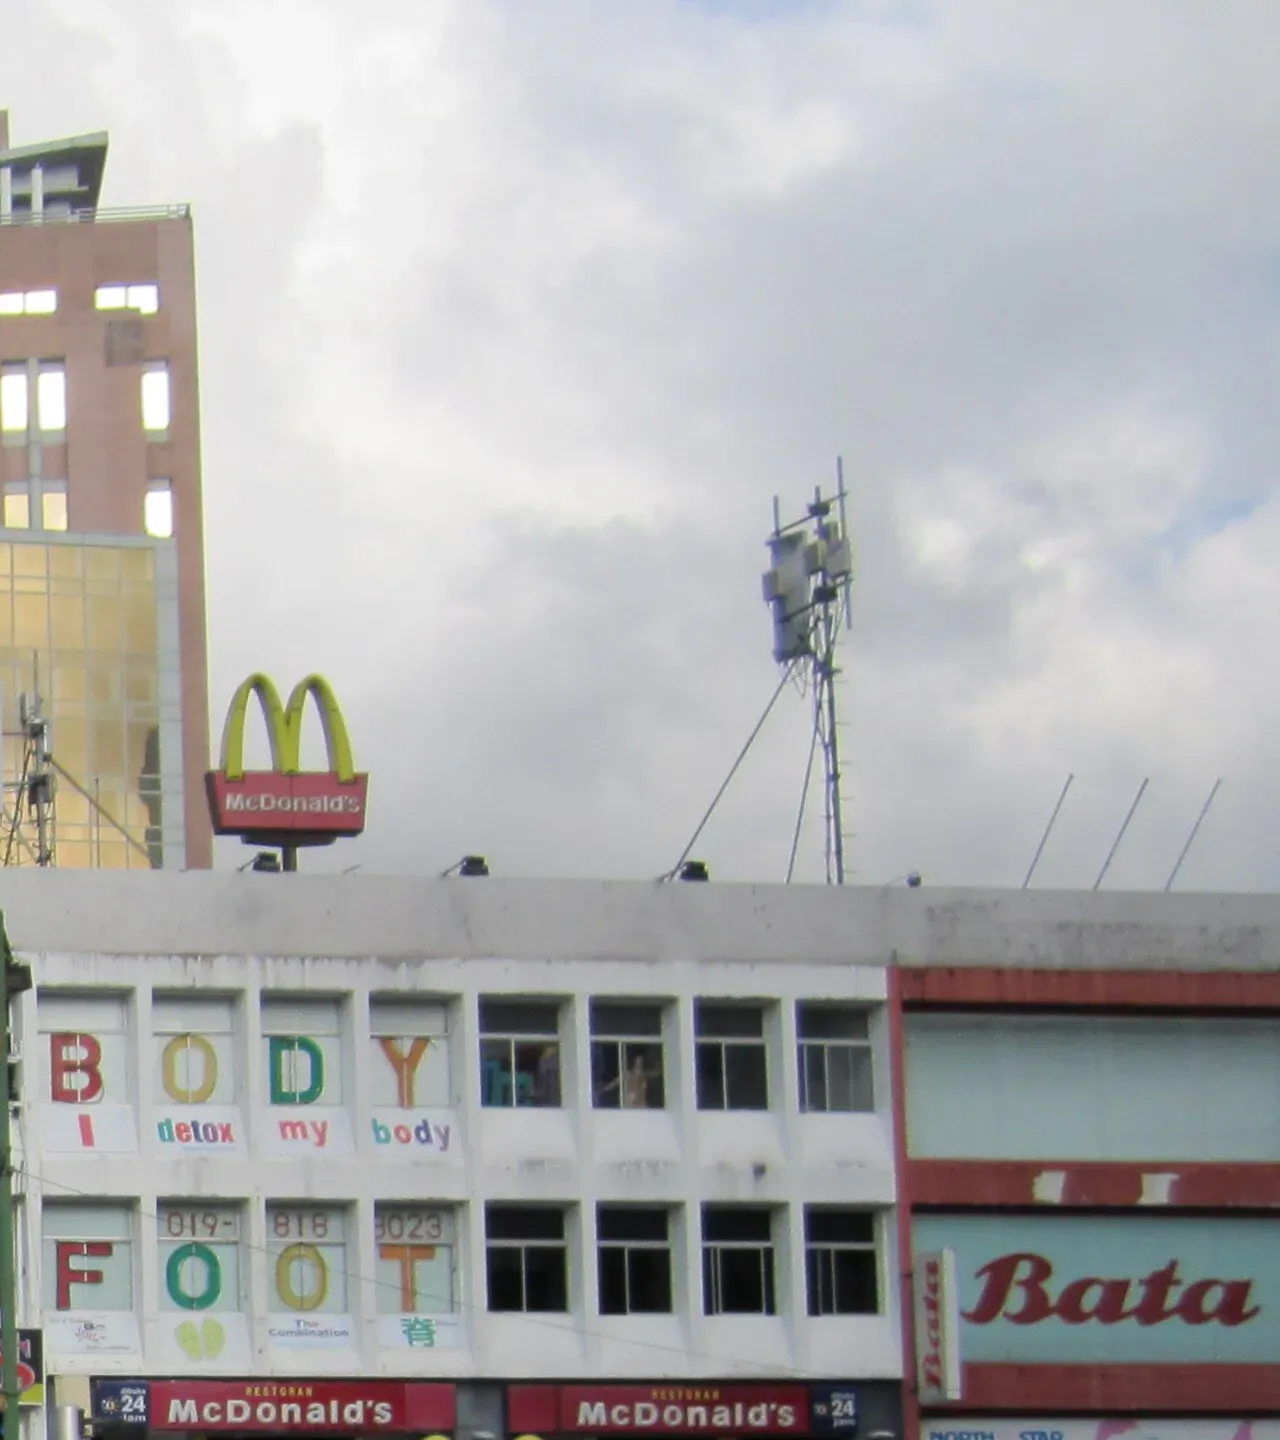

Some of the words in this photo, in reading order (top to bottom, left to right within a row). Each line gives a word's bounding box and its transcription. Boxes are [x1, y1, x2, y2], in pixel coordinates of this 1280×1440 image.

[225, 792, 361, 813] McDonald's
[50, 1032, 431, 1109] BODY
[157, 1118, 235, 1144] detox
[279, 1119, 328, 1147] my
[371, 1117, 450, 1151] body
[274, 1212, 328, 1238] 818
[56, 1241, 436, 1313] FOOT
[960, 1253, 1261, 1327] Bata
[268, 1328, 350, 1338] Combination
[923, 1260, 940, 1387] Bata
[121, 1395, 146, 1412] 24
[245, 1386, 313, 1397] RESTORAN
[167, 1399, 393, 1424] McDonald's
[576, 1401, 797, 1427] McDonald's
[831, 1400, 854, 1417] 24
